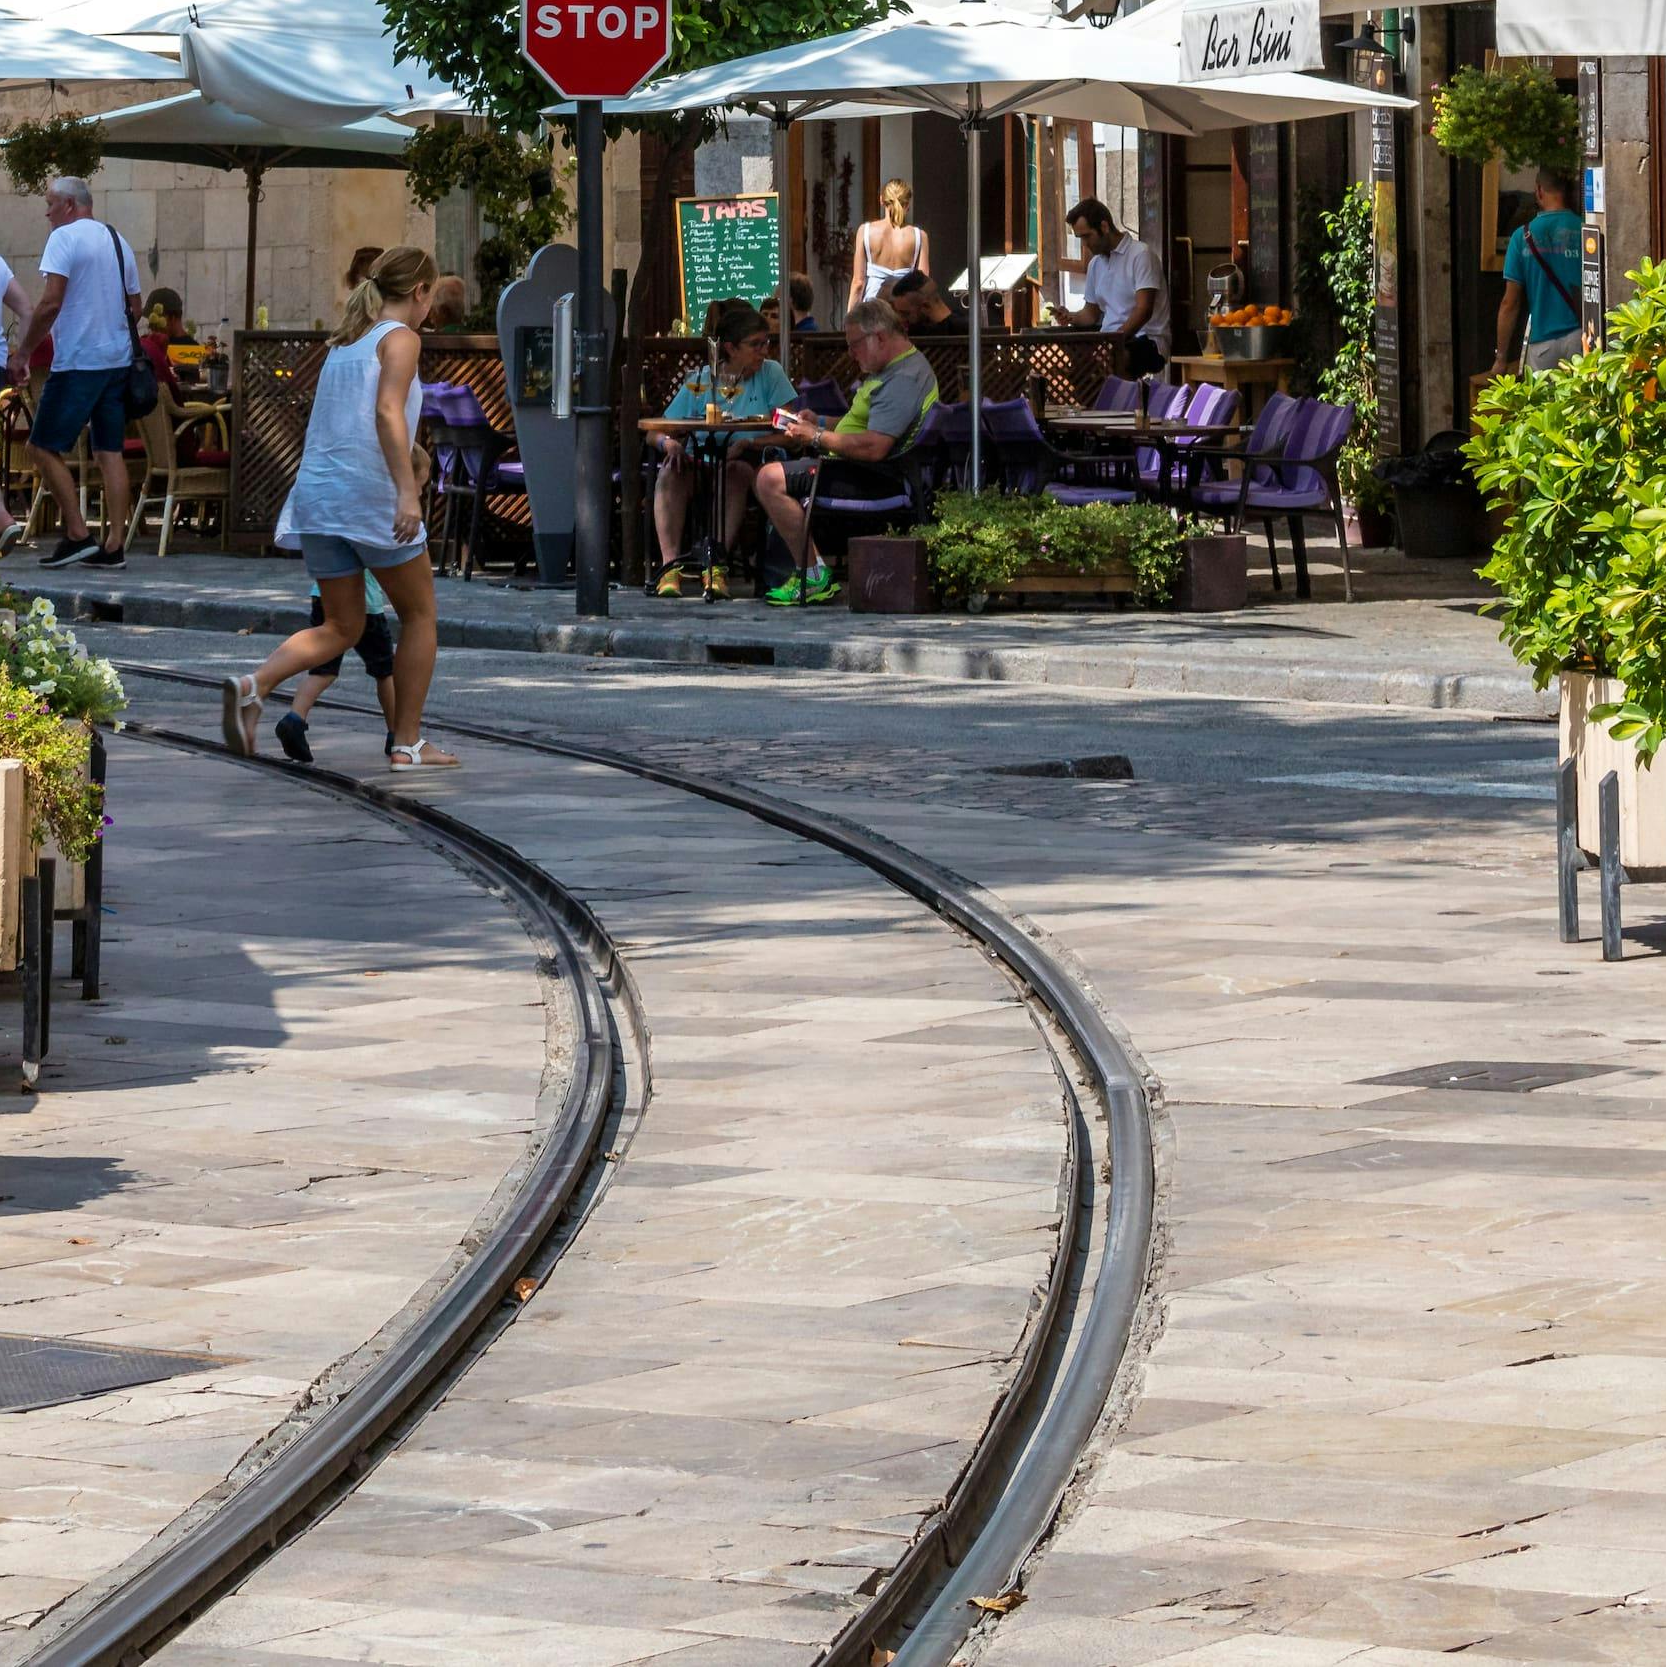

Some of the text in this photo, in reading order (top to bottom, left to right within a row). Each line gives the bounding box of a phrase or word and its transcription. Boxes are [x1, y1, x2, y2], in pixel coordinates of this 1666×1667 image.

[534, 4, 660, 40] STOP
[1201, 7, 1294, 71] Bar Bini
[695, 199, 767, 222] TAPAS
